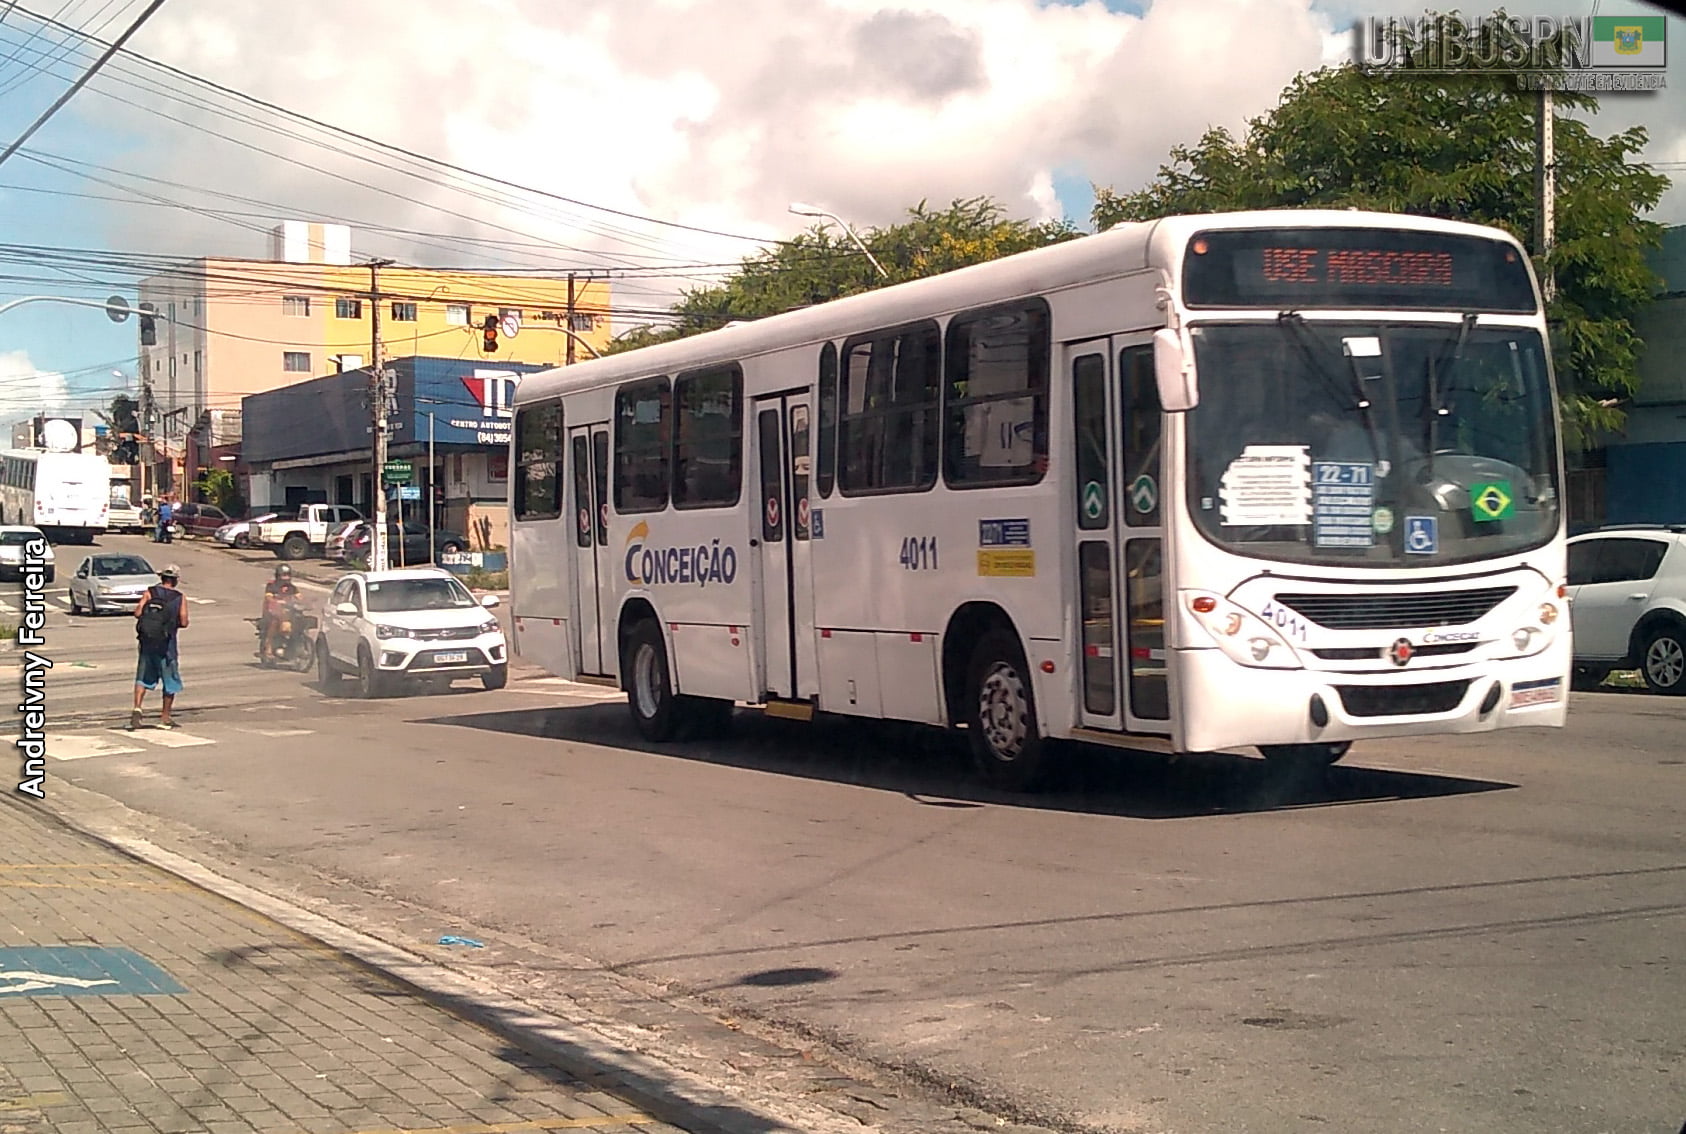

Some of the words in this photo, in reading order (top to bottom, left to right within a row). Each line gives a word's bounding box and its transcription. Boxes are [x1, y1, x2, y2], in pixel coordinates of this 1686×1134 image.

[450, 420, 478, 429] CENTRO
[625, 538, 736, 587] CONCEIÇÃO
[899, 536, 938, 570] 4011
[1261, 602, 1308, 642] 4011
